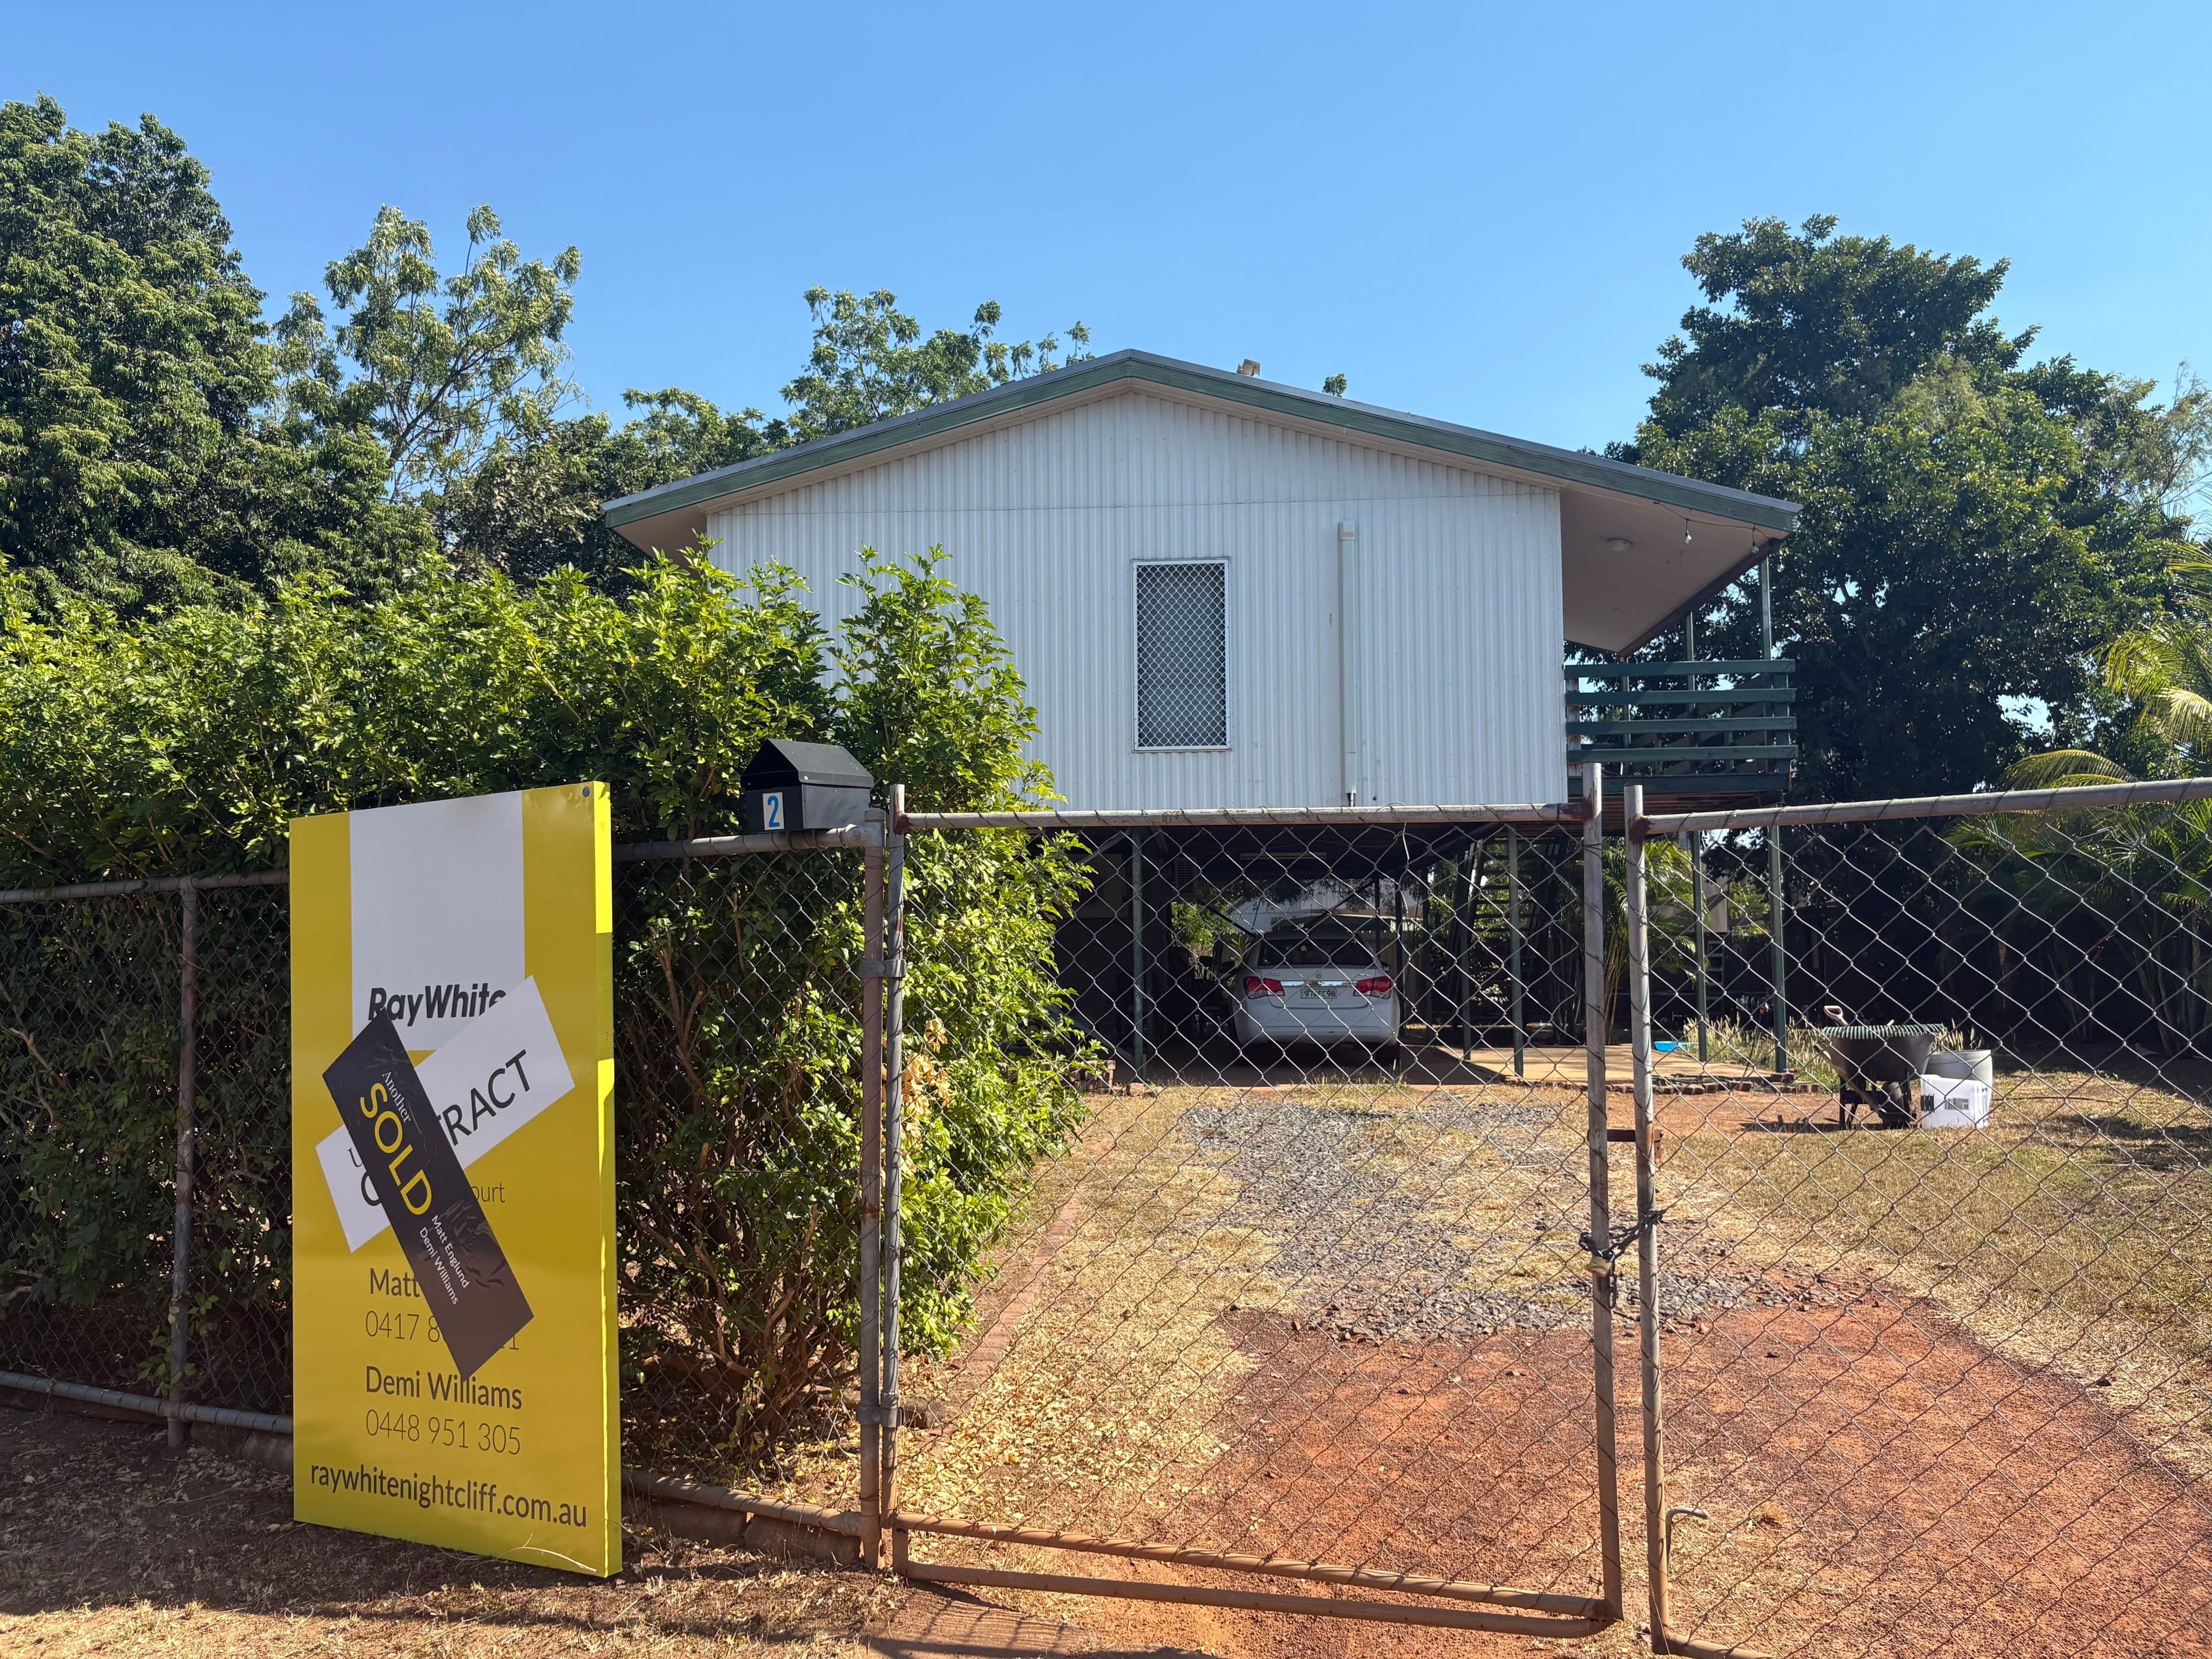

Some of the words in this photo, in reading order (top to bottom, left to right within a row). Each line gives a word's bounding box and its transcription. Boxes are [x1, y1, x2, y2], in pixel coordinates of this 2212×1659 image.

[767, 796, 780, 827] 2
[382, 1071, 411, 1123] Another
[360, 1082, 433, 1215] SOLD
[419, 1227, 438, 1258] Demi
[434, 1256, 459, 1305] Williams
[431, 1215, 448, 1244] Matt
[445, 1243, 470, 1289] Englund
[370, 1268, 420, 1297] Matt
[366, 1310, 419, 1340] 0417
[366, 1366, 420, 1398] Demi
[427, 1372, 522, 1410] Williams
[366, 1409, 420, 1441] 0448
[429, 1416, 469, 1448] 951
[478, 1423, 520, 1455] 305
[311, 1464, 586, 1528] raywhitenightcliff.com.au
